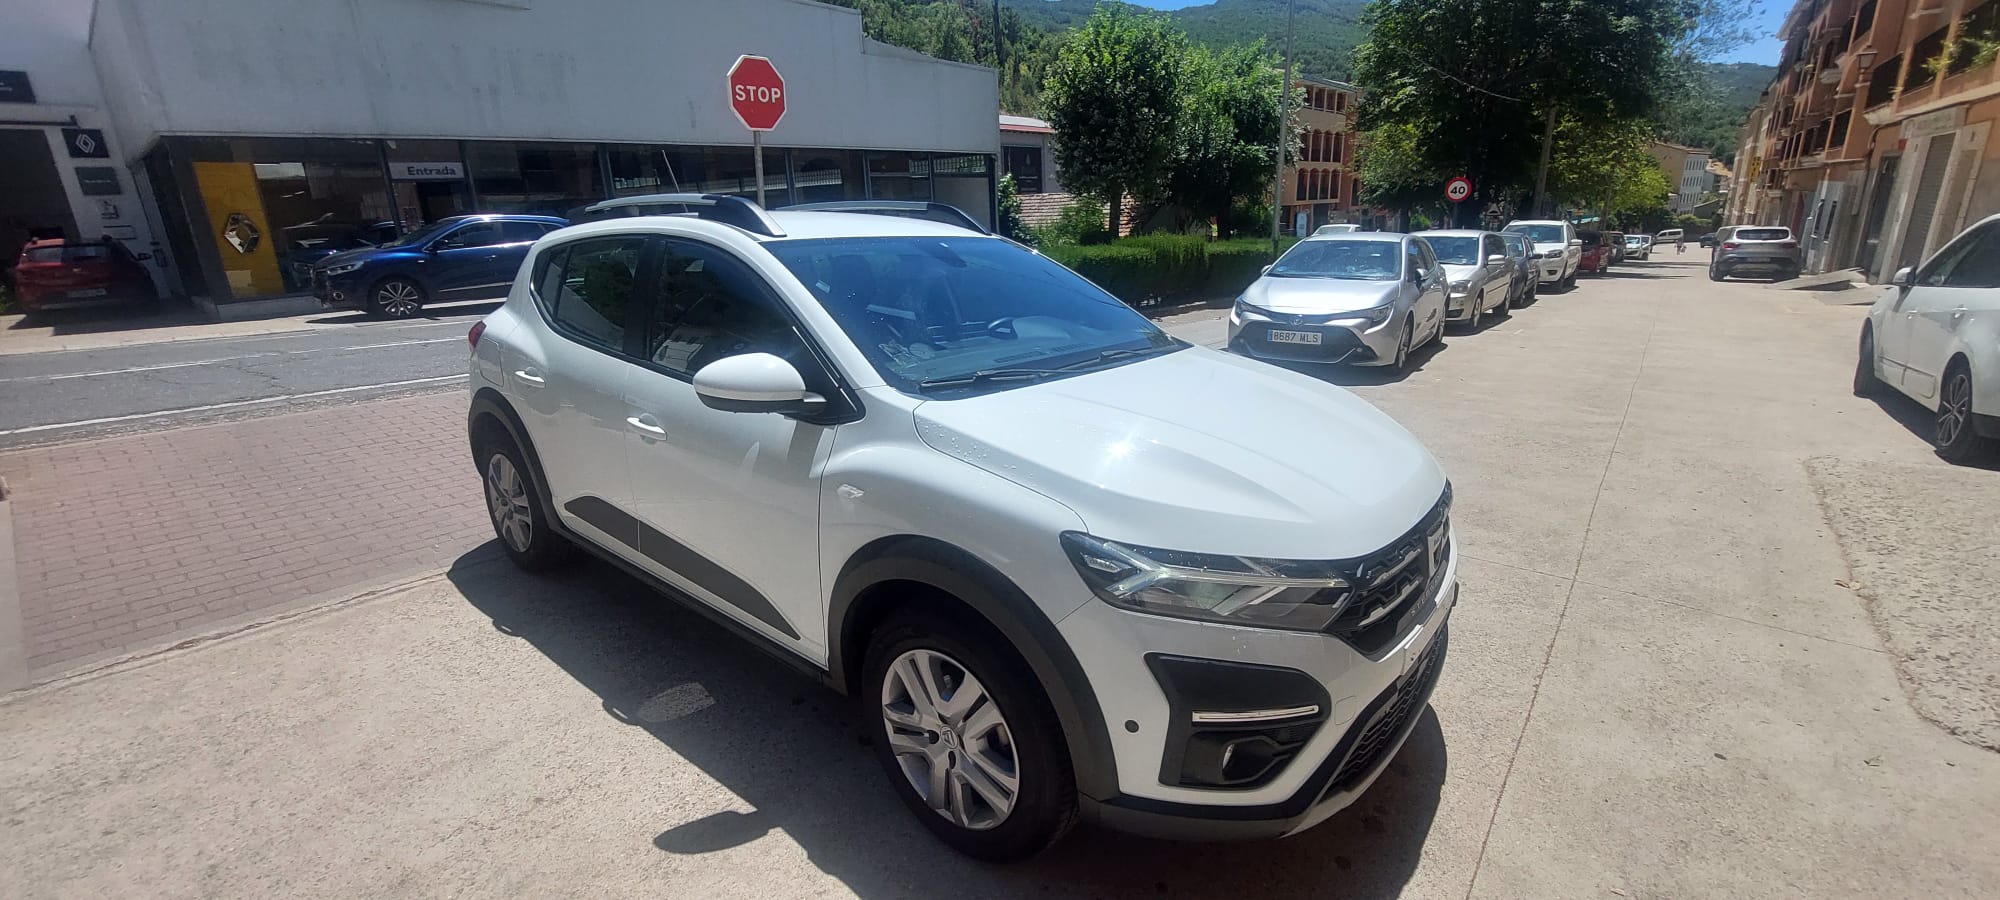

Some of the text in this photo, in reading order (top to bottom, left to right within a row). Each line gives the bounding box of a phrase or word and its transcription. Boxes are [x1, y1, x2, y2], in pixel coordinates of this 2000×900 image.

[735, 84, 781, 104] STOP
[407, 165, 456, 176] Entrada
[1450, 186, 1466, 194] 40
[1273, 331, 1319, 343] 8687 MLS
